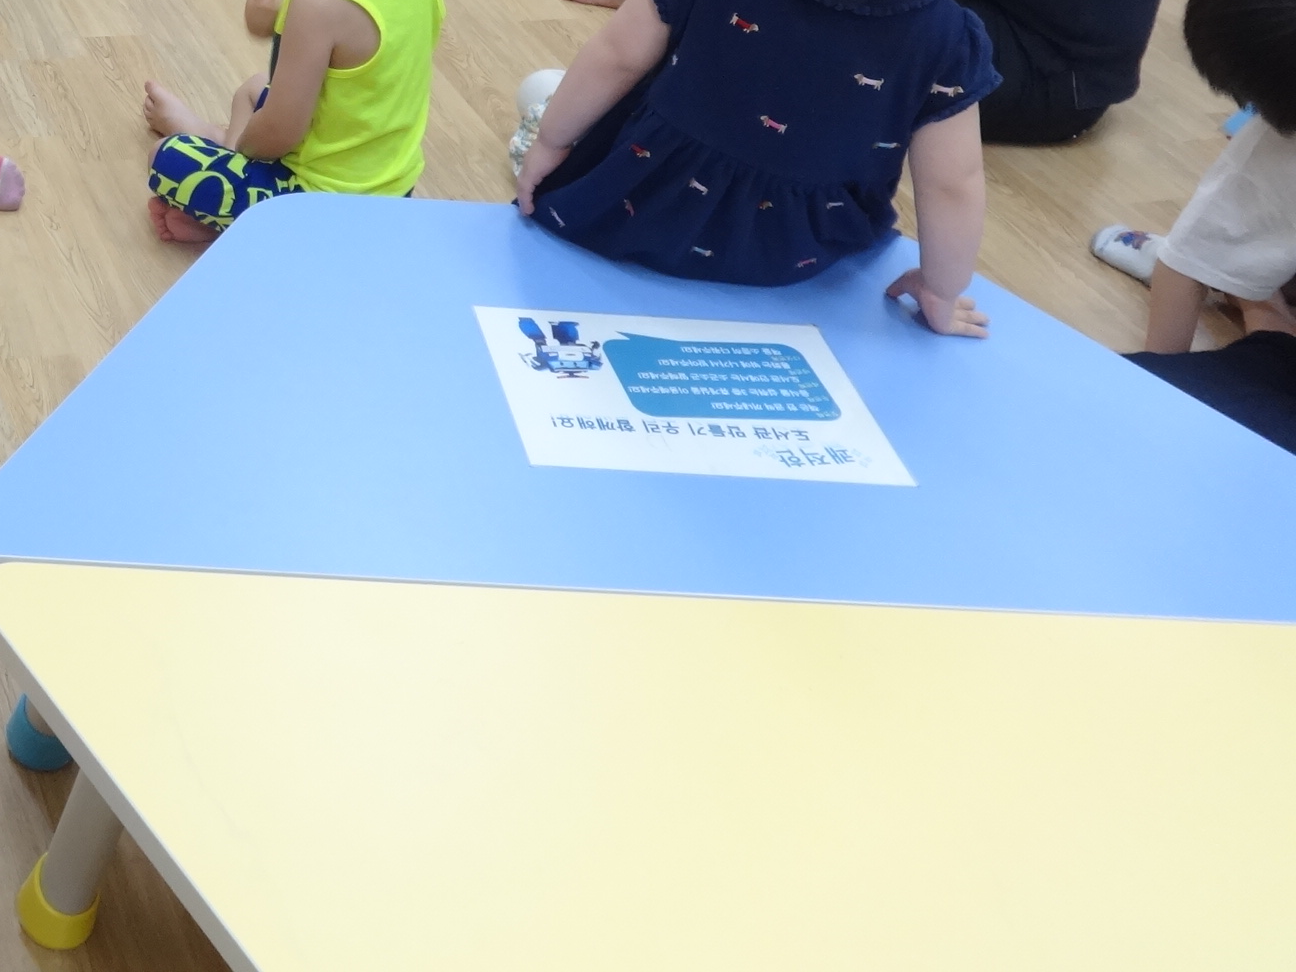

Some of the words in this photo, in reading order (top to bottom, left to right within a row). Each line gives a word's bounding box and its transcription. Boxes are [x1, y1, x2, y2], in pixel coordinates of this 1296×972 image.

[657, 358, 708, 368] 받아주세요!
[710, 359, 739, 368] 나가서
[637, 371, 689, 381] 말해주세요!
[689, 373, 728, 382] 소곤소곤
[730, 373, 769, 382] 안에서는
[769, 374, 800, 383] 도서관
[627, 385, 689, 395] 이용해주세요!
[731, 387, 748, 396] 3층
[712, 402, 762, 410] 꺼내주세요!
[786, 403, 798, 412] 한
[549, 416, 636, 434] 함께해요!
[640, 419, 680, 435] 우리
[687, 422, 747, 439] 만들기
[752, 427, 810, 442] 도서관
[776, 446, 855, 468] 쾌적한
